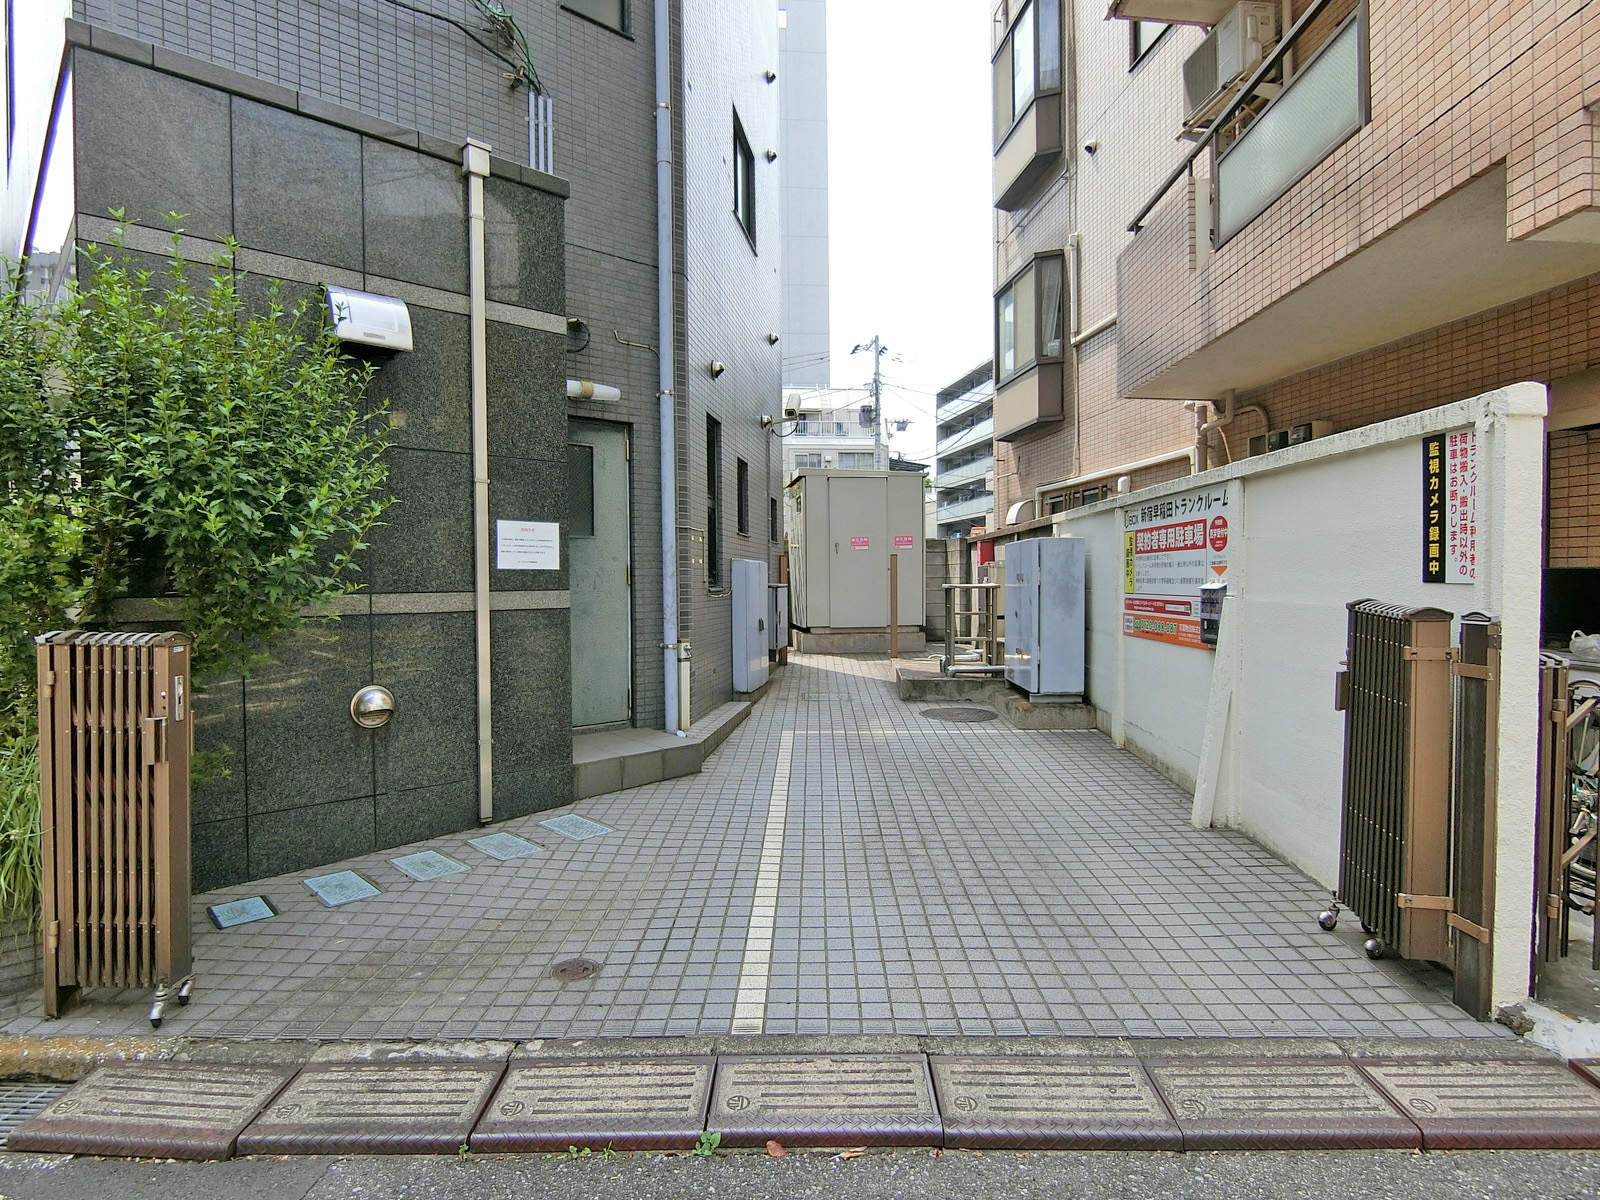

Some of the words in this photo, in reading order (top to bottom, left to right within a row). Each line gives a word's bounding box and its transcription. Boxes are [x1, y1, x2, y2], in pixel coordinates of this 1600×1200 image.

[1136, 523, 1204, 551] 契約者専用駐車場
[1429, 442, 1440, 575] 監視カメラ録画中
[1450, 435, 1458, 562] 駐車はお断りします。
[1459, 432, 1468, 576] 荷物搬入・搬出時以外の
